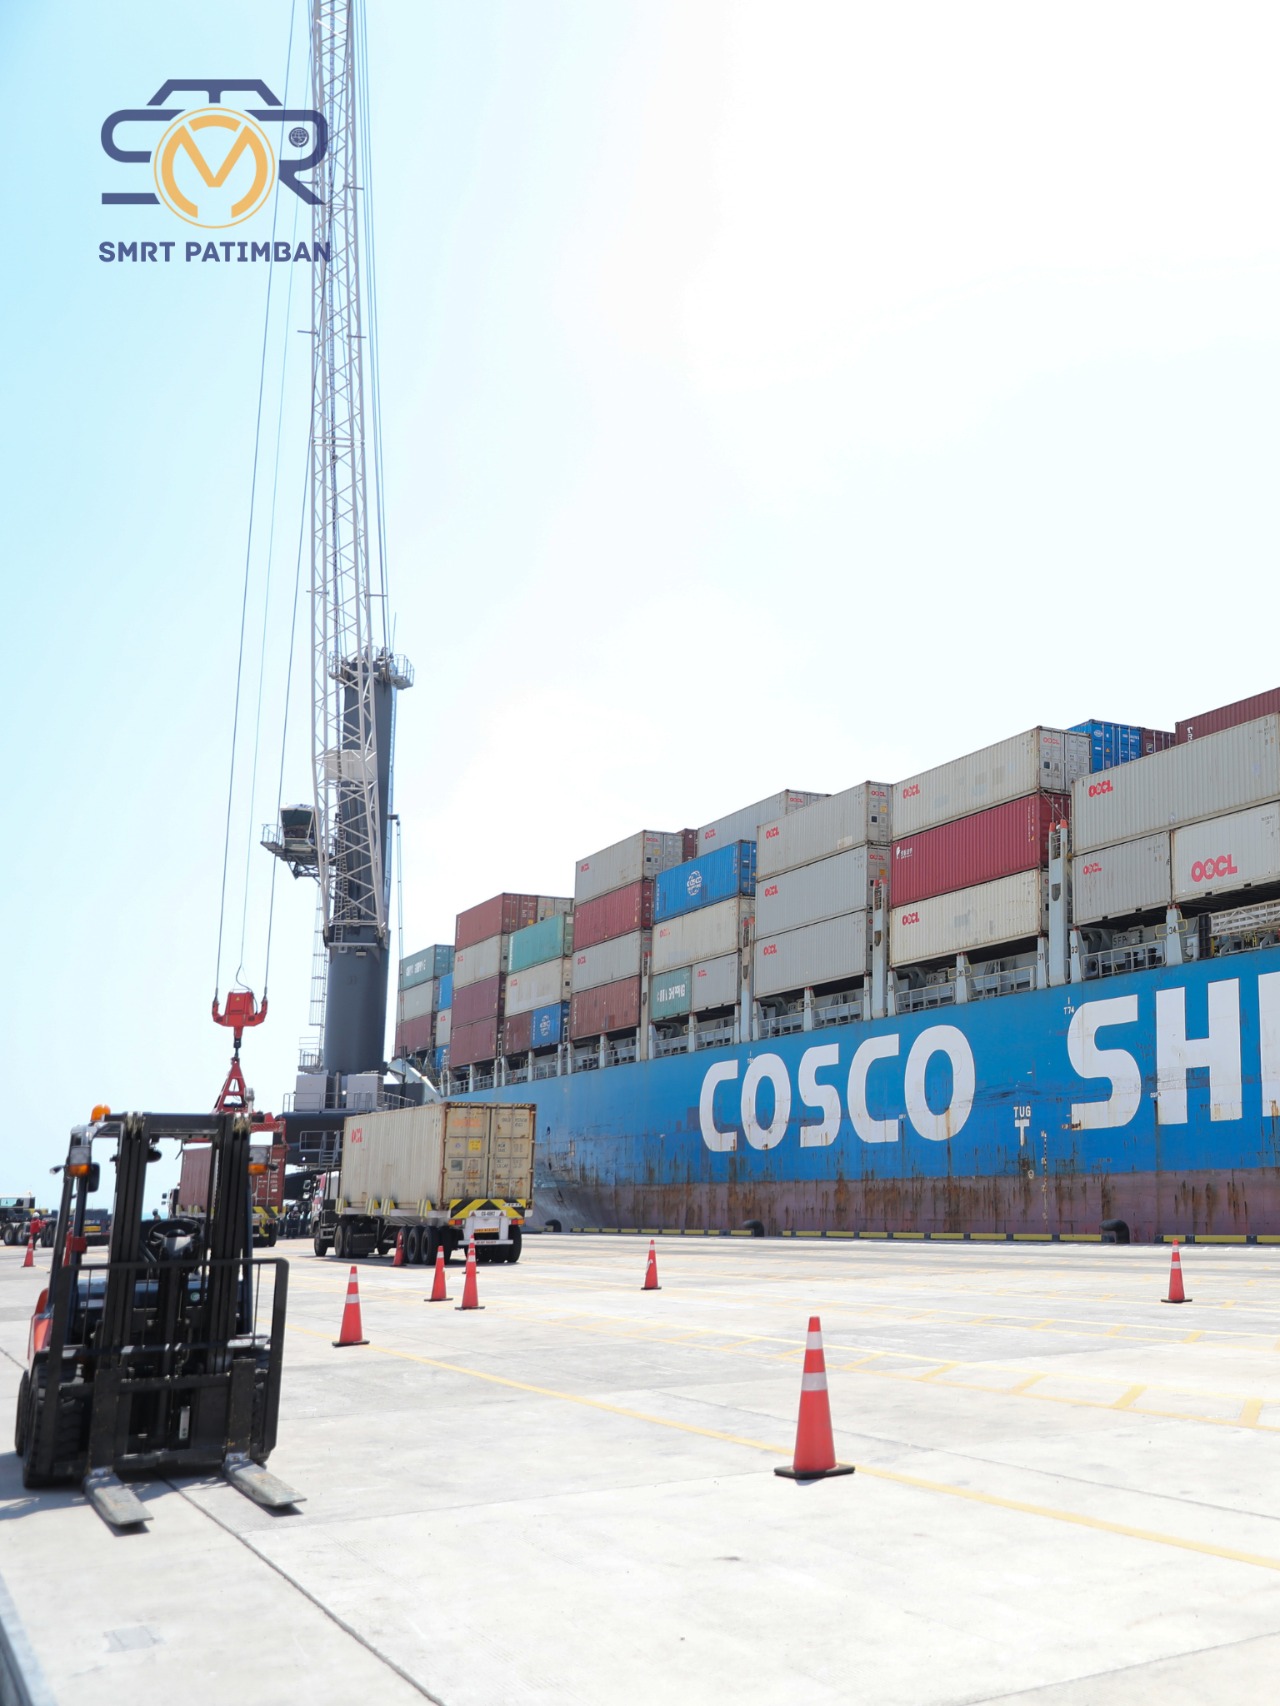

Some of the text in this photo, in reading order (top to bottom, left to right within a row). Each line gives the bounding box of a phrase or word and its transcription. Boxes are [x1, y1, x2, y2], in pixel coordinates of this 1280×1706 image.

[1043, 737, 1060, 745] OOCL
[870, 789, 886, 798] OOCL
[903, 783, 921, 799] OOCL
[1088, 779, 1114, 797] OOCL
[1191, 853, 1239, 883] OOCL
[902, 912, 921, 926] OOCL
[1168, 926, 1177, 935] 34
[1063, 1006, 1075, 1016] T74
[699, 1024, 976, 1152] COSCO
[1013, 1105, 1032, 1118] TUG
